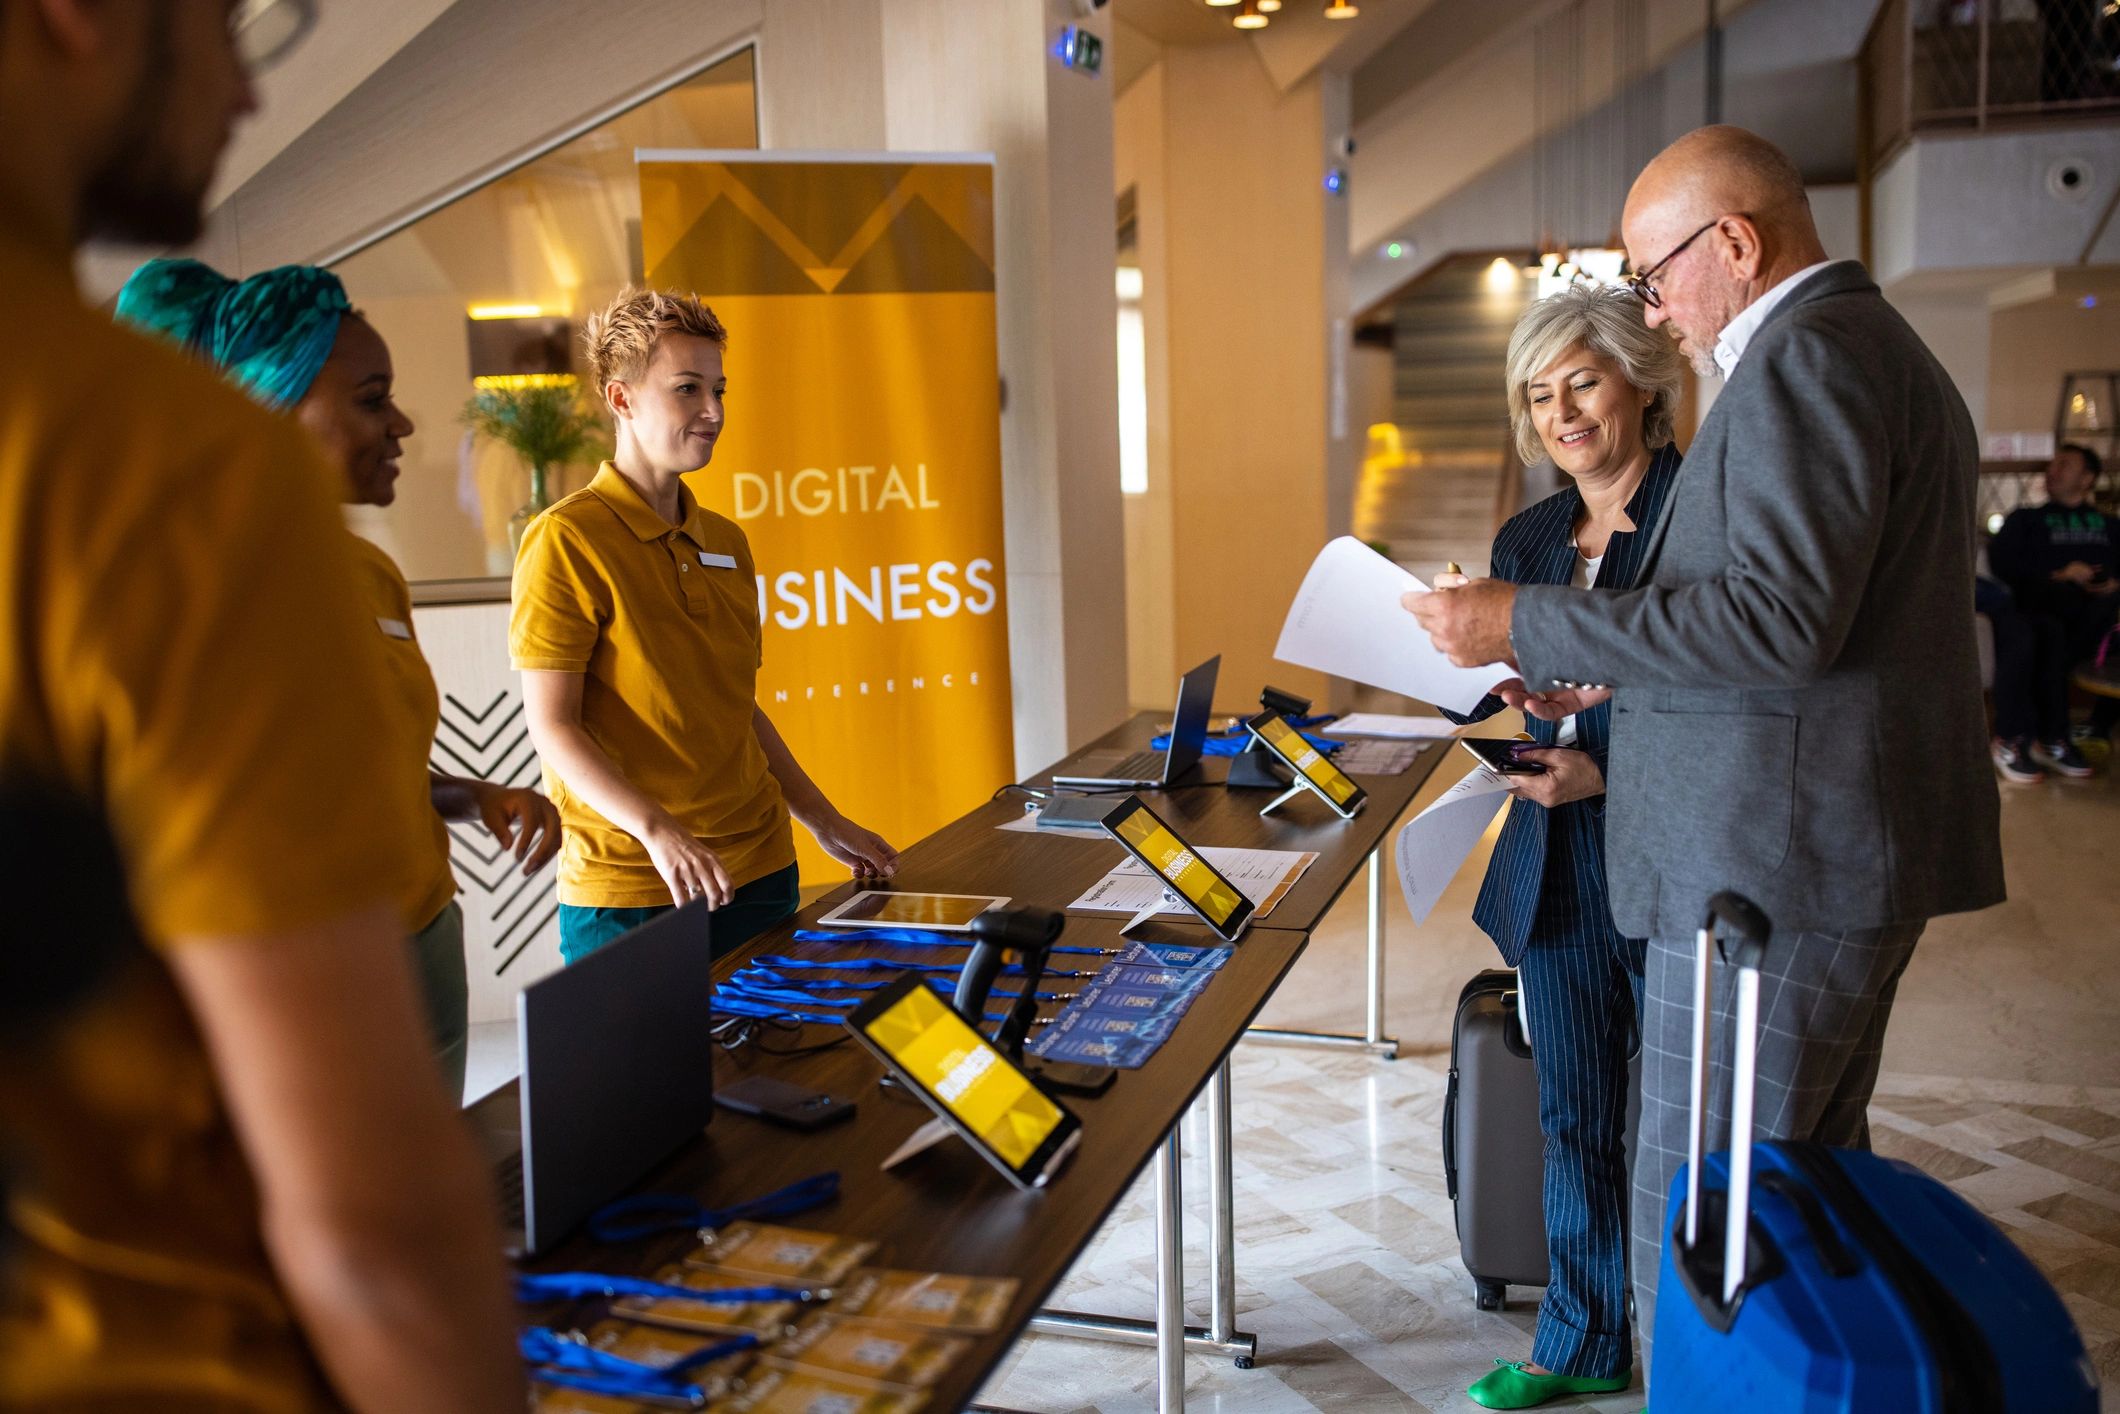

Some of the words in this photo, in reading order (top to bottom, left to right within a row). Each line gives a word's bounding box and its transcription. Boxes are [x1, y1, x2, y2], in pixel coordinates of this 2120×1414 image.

[733, 464, 940, 519] DIGITAL
[756, 558, 996, 630] SINESS
[775, 672, 979, 703] NFERENCE
[1163, 849, 1195, 880] BUSINESS
